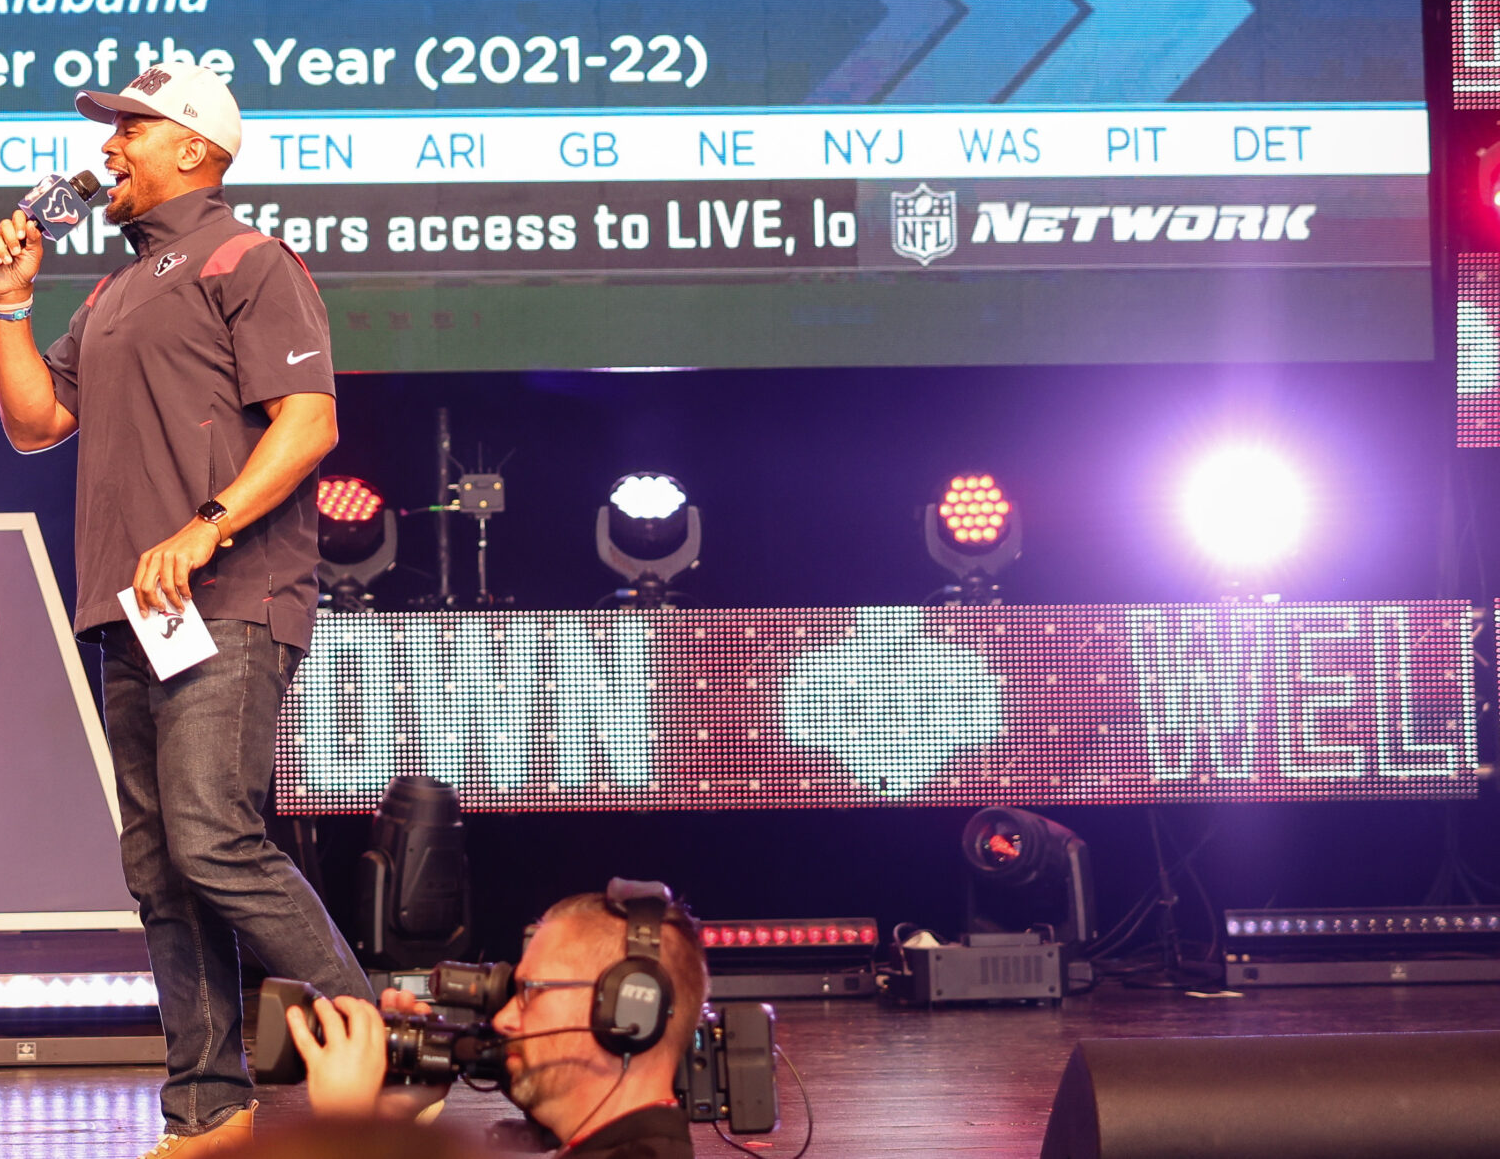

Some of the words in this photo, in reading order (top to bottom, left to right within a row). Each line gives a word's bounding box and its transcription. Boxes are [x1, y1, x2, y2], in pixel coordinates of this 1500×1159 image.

[53, 39, 118, 87] of
[134, 37, 234, 84] the
[253, 38, 395, 86] Year
[415, 35, 708, 90] (2021-22)
[0, 136, 68, 172] CHI
[270, 134, 352, 169] TEN
[416, 133, 484, 168] ARI
[559, 132, 618, 166] GB
[700, 131, 755, 166] NE
[824, 130, 904, 164] NYJ
[959, 129, 1041, 163] WAS
[1107, 127, 1167, 162] PIT
[1233, 126, 1311, 161] DET
[232, 203, 367, 253] ffers
[388, 213, 576, 252] access
[594, 203, 648, 250] to
[667, 199, 796, 256] LIVE,
[813, 198, 855, 248] lo
[899, 216, 949, 248] NFL
[971, 202, 1316, 243] NETWORK
[1125, 603, 1478, 779] WEL
